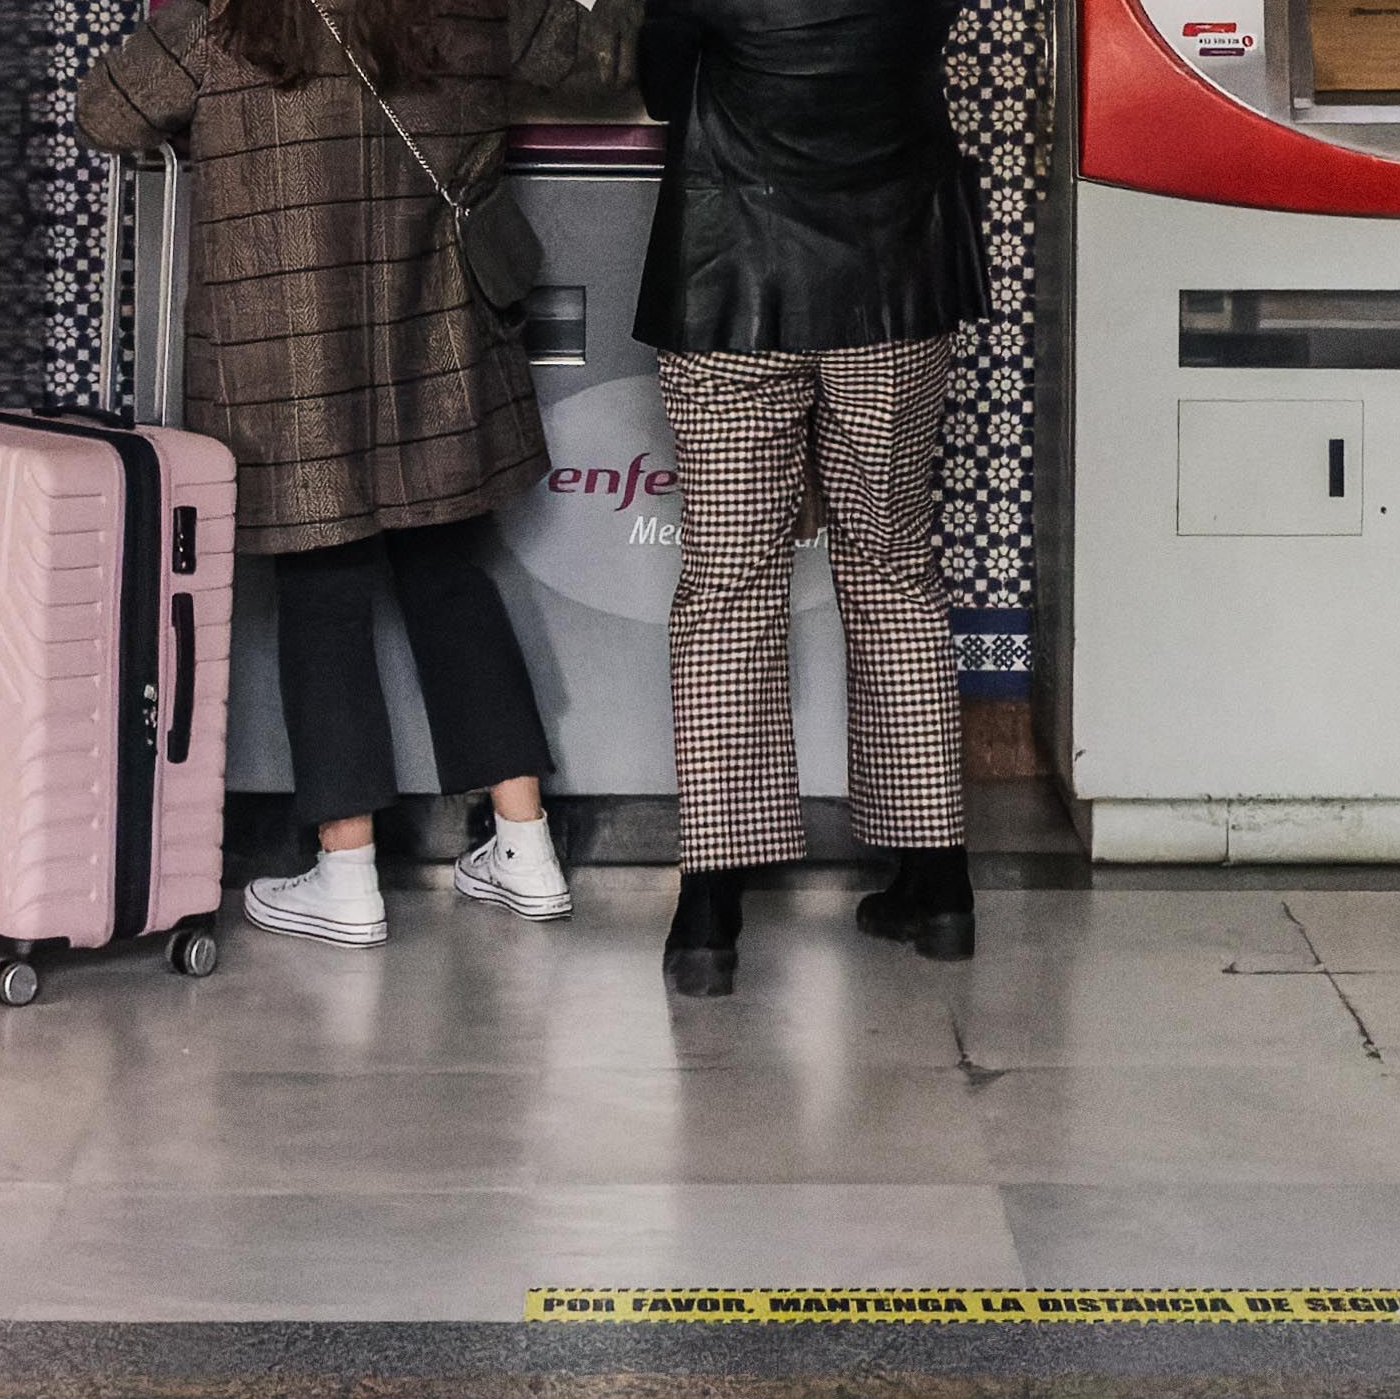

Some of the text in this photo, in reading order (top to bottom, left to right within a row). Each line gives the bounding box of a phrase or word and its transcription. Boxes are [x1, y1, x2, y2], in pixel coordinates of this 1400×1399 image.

[548, 453, 680, 512] enfe
[543, 1298, 615, 1312] POR
[769, 1298, 967, 1313] MANTENGA
[982, 1298, 1025, 1313] LA
[1039, 1298, 1234, 1313] DISTANCIA
[1245, 1298, 1293, 1313] DE
